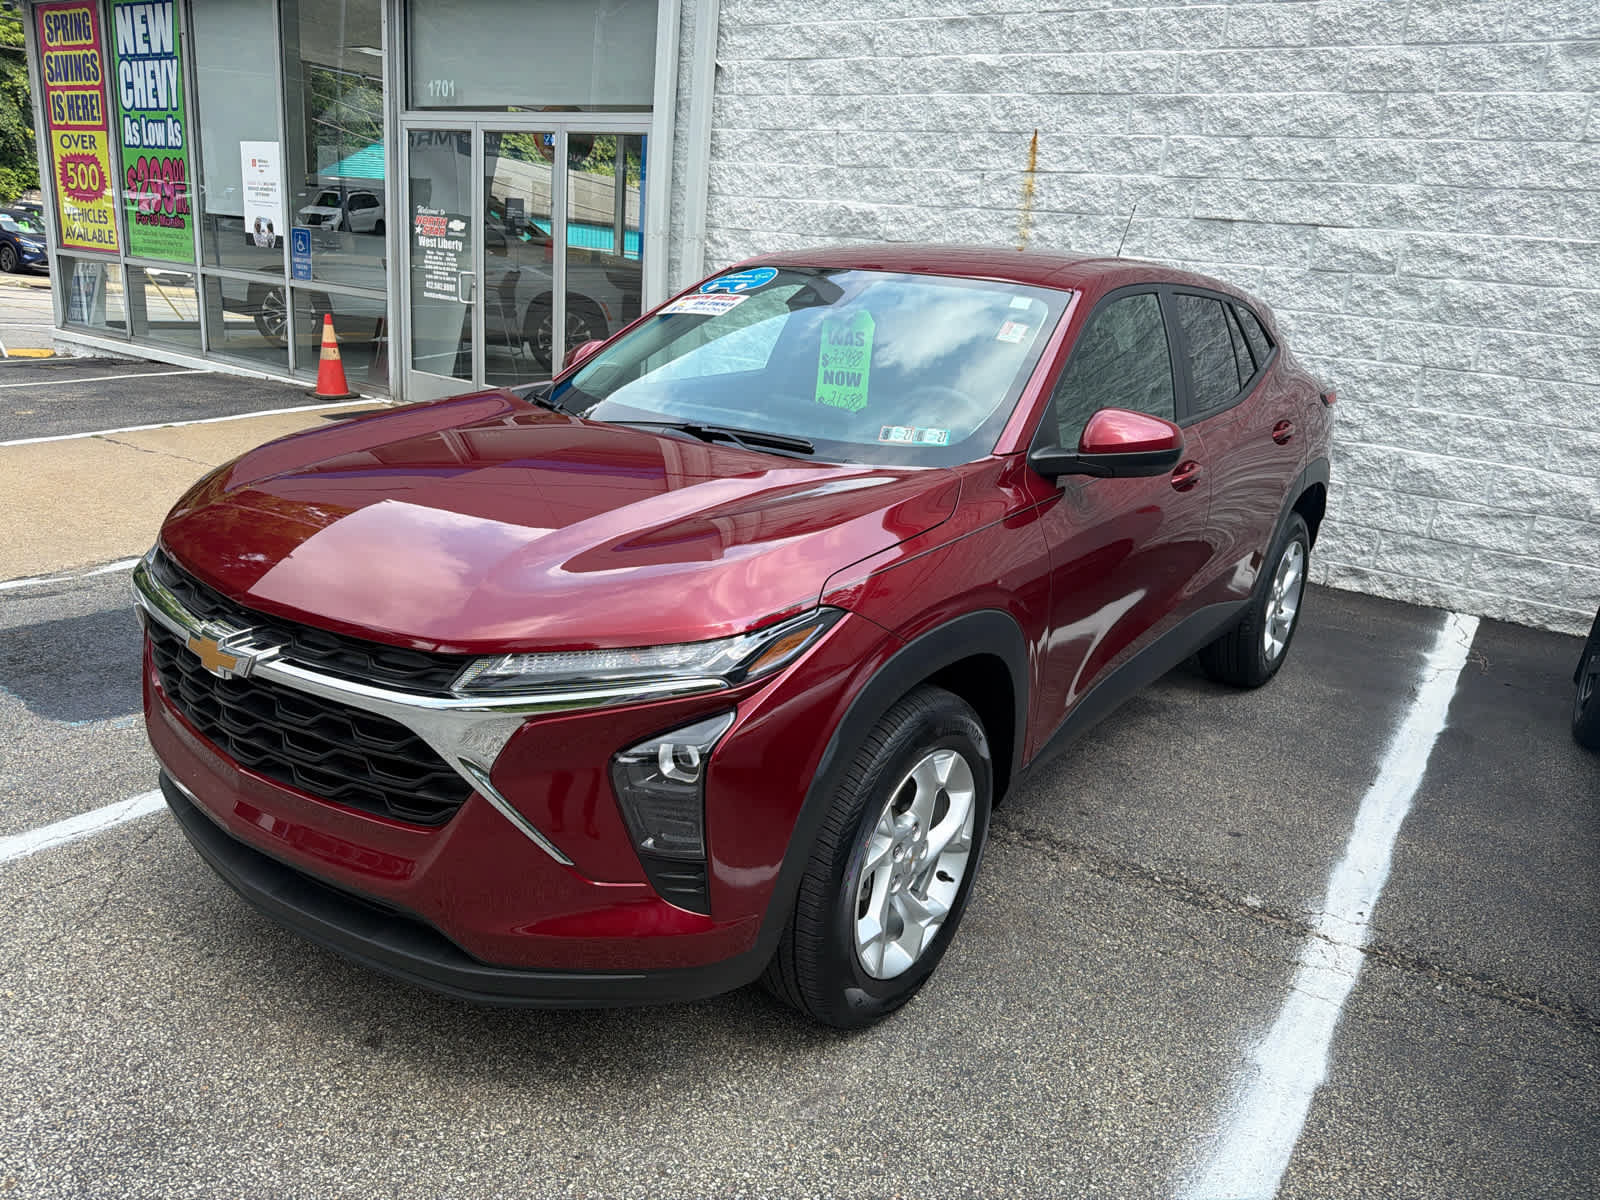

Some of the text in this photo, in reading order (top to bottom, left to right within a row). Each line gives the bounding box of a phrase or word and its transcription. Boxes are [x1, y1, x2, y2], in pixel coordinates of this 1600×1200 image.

[44, 10, 92, 43] SPRING
[114, 1, 174, 56] NEW
[45, 52, 100, 83] SAVINGS
[118, 58, 178, 110] CHEVY
[428, 79, 455, 97] 1701
[51, 93, 101, 122] IS HERE!
[59, 133, 97, 150] OVER
[66, 161, 100, 192] 500
[65, 206, 109, 225] VEHICLES
[415, 215, 448, 226] NORTH
[65, 225, 116, 245] AVAILABLE
[422, 225, 447, 237] STAR
[418, 235, 463, 252] West Liberty
[829, 330, 865, 347] WAS
[823, 370, 862, 387] NOW
